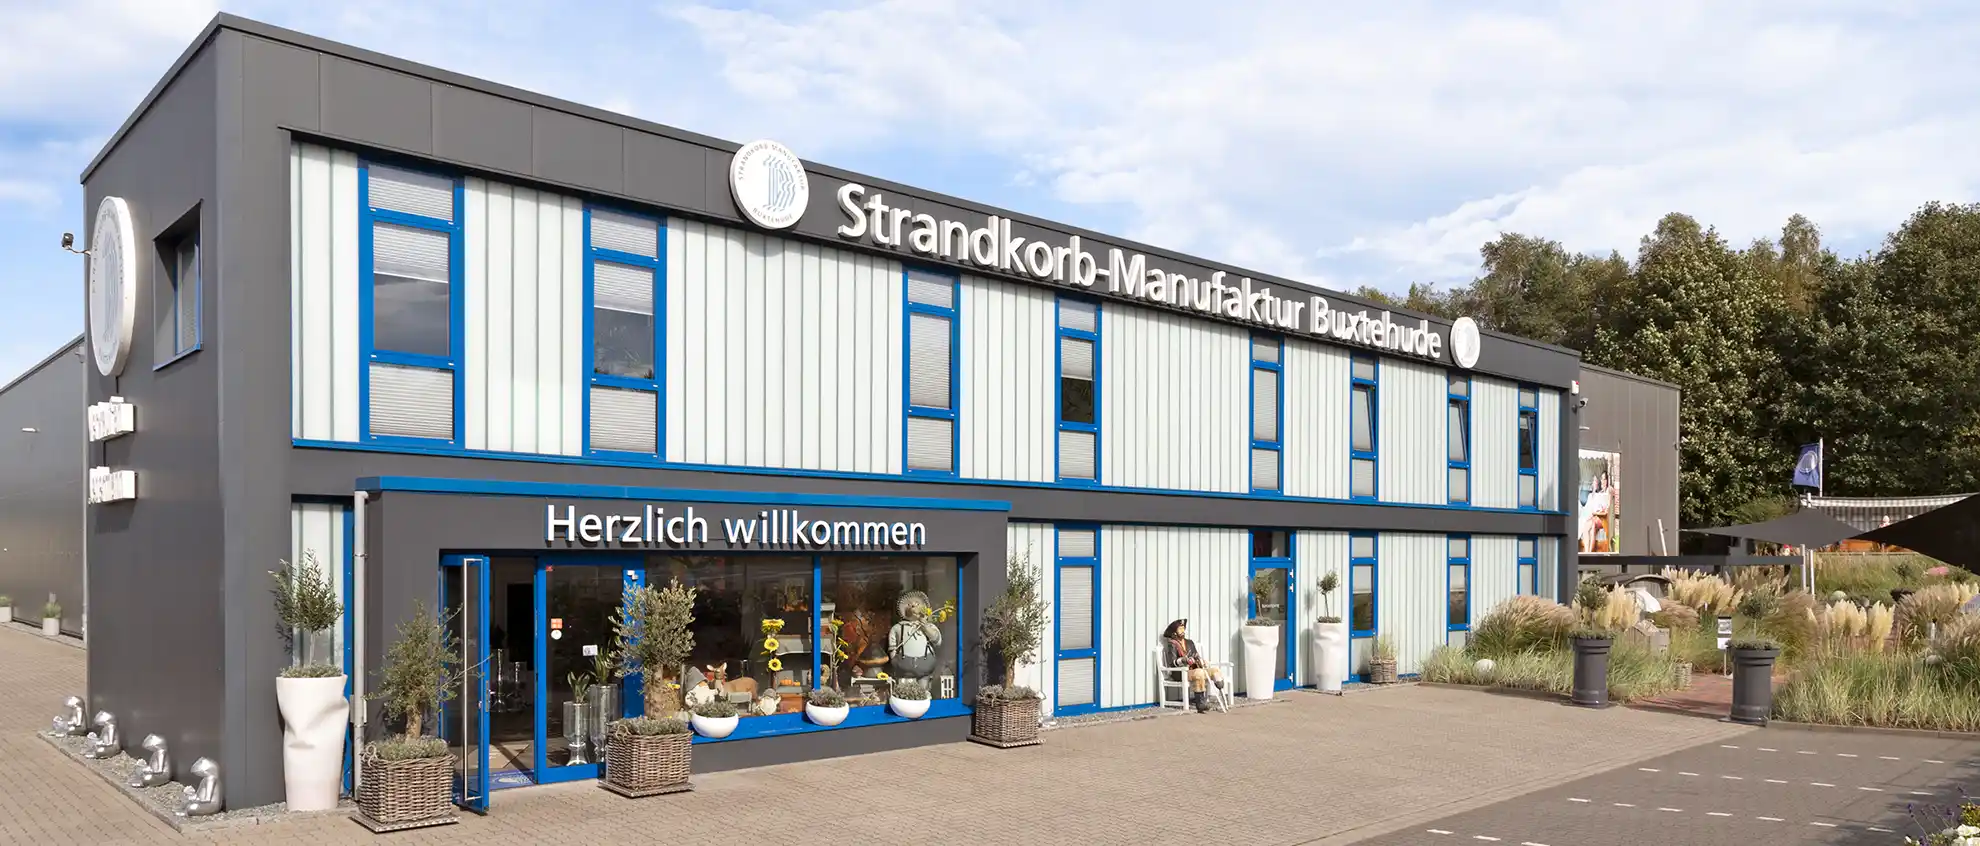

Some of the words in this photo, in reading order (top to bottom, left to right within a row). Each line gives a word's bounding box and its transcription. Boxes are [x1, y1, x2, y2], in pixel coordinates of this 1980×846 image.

[837, 182, 1304, 330] Strandkorb-Manufaktur
[1310, 296, 1442, 358] Buxtehude
[546, 504, 708, 544] Herzlich
[723, 509, 926, 546] willkommen
